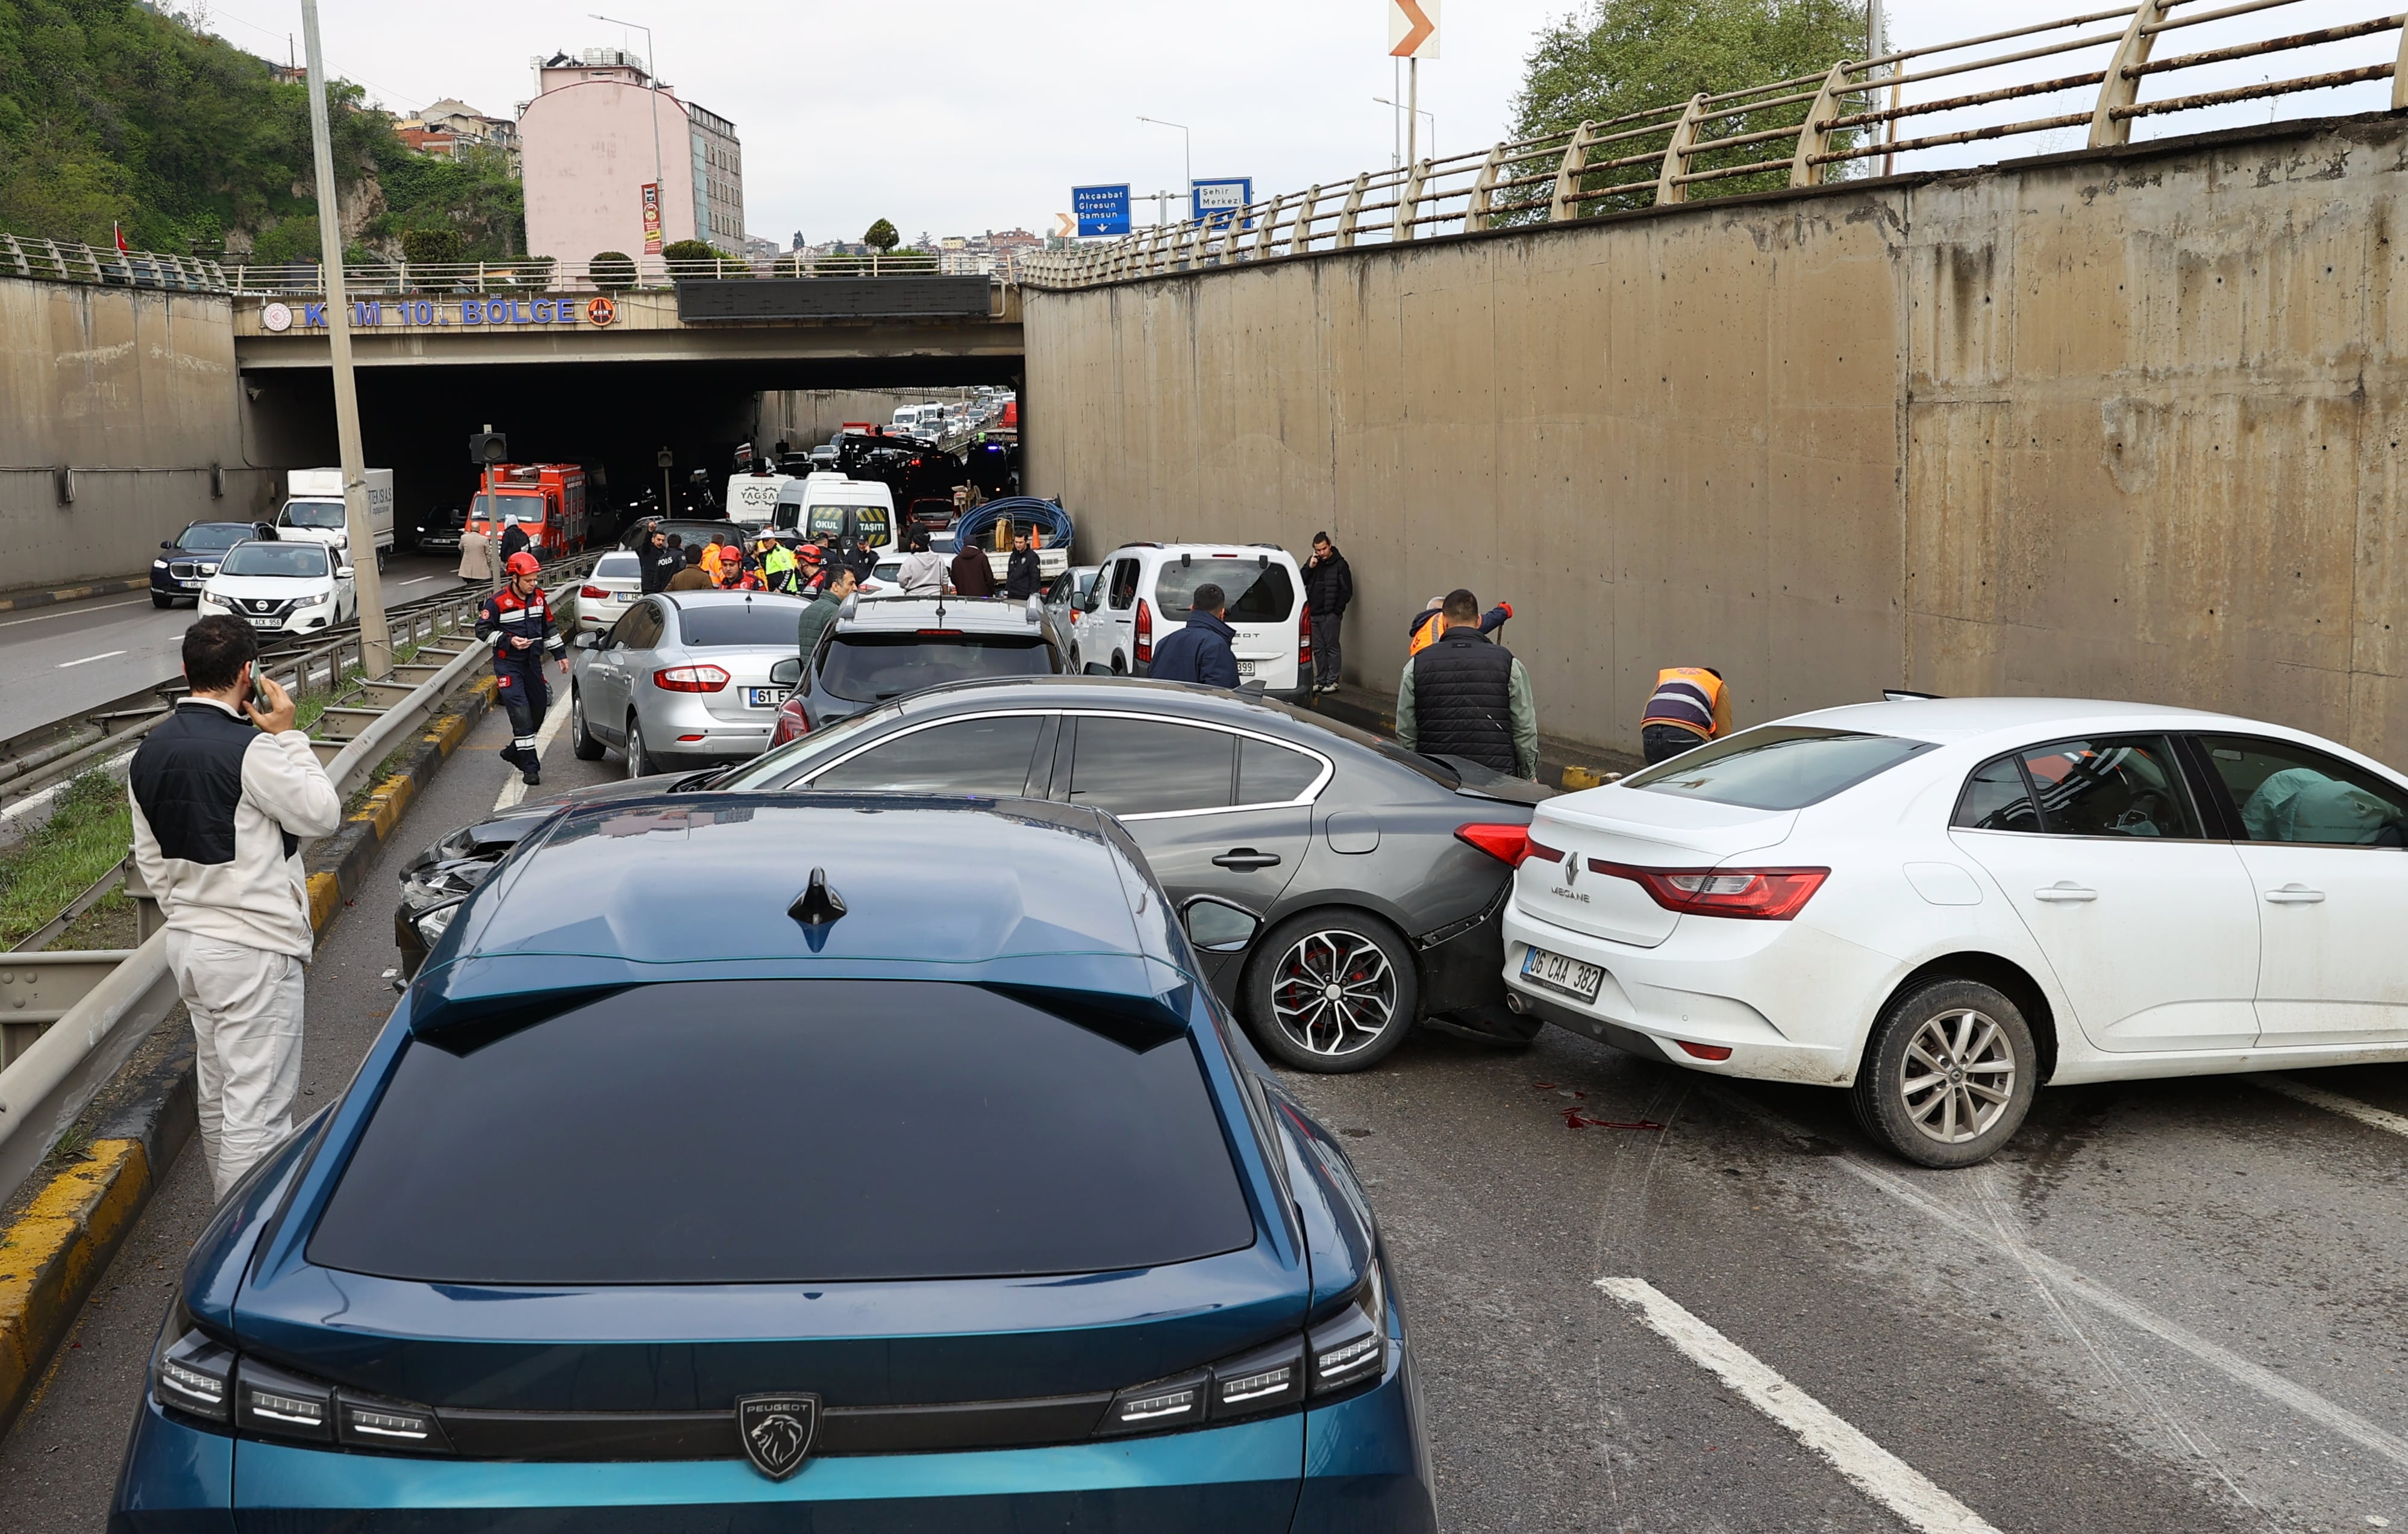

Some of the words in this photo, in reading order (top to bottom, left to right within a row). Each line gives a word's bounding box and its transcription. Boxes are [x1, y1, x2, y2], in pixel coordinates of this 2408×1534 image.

[1079, 191, 1123, 201] Akçaabat
[304, 301, 381, 327] KM
[397, 299, 448, 326] 10.
[462, 293, 575, 325] BÖLGE
[815, 520, 838, 529] OKUL
[859, 523, 884, 532] TAŞITI
[758, 690, 771, 702] 61
[1551, 886, 1590, 903] MEGANE
[1530, 950, 1546, 974] 06
[1547, 956, 1570, 983] CAA
[1574, 965, 1598, 993] 382
[747, 1403, 808, 1413] PEUGEOT
